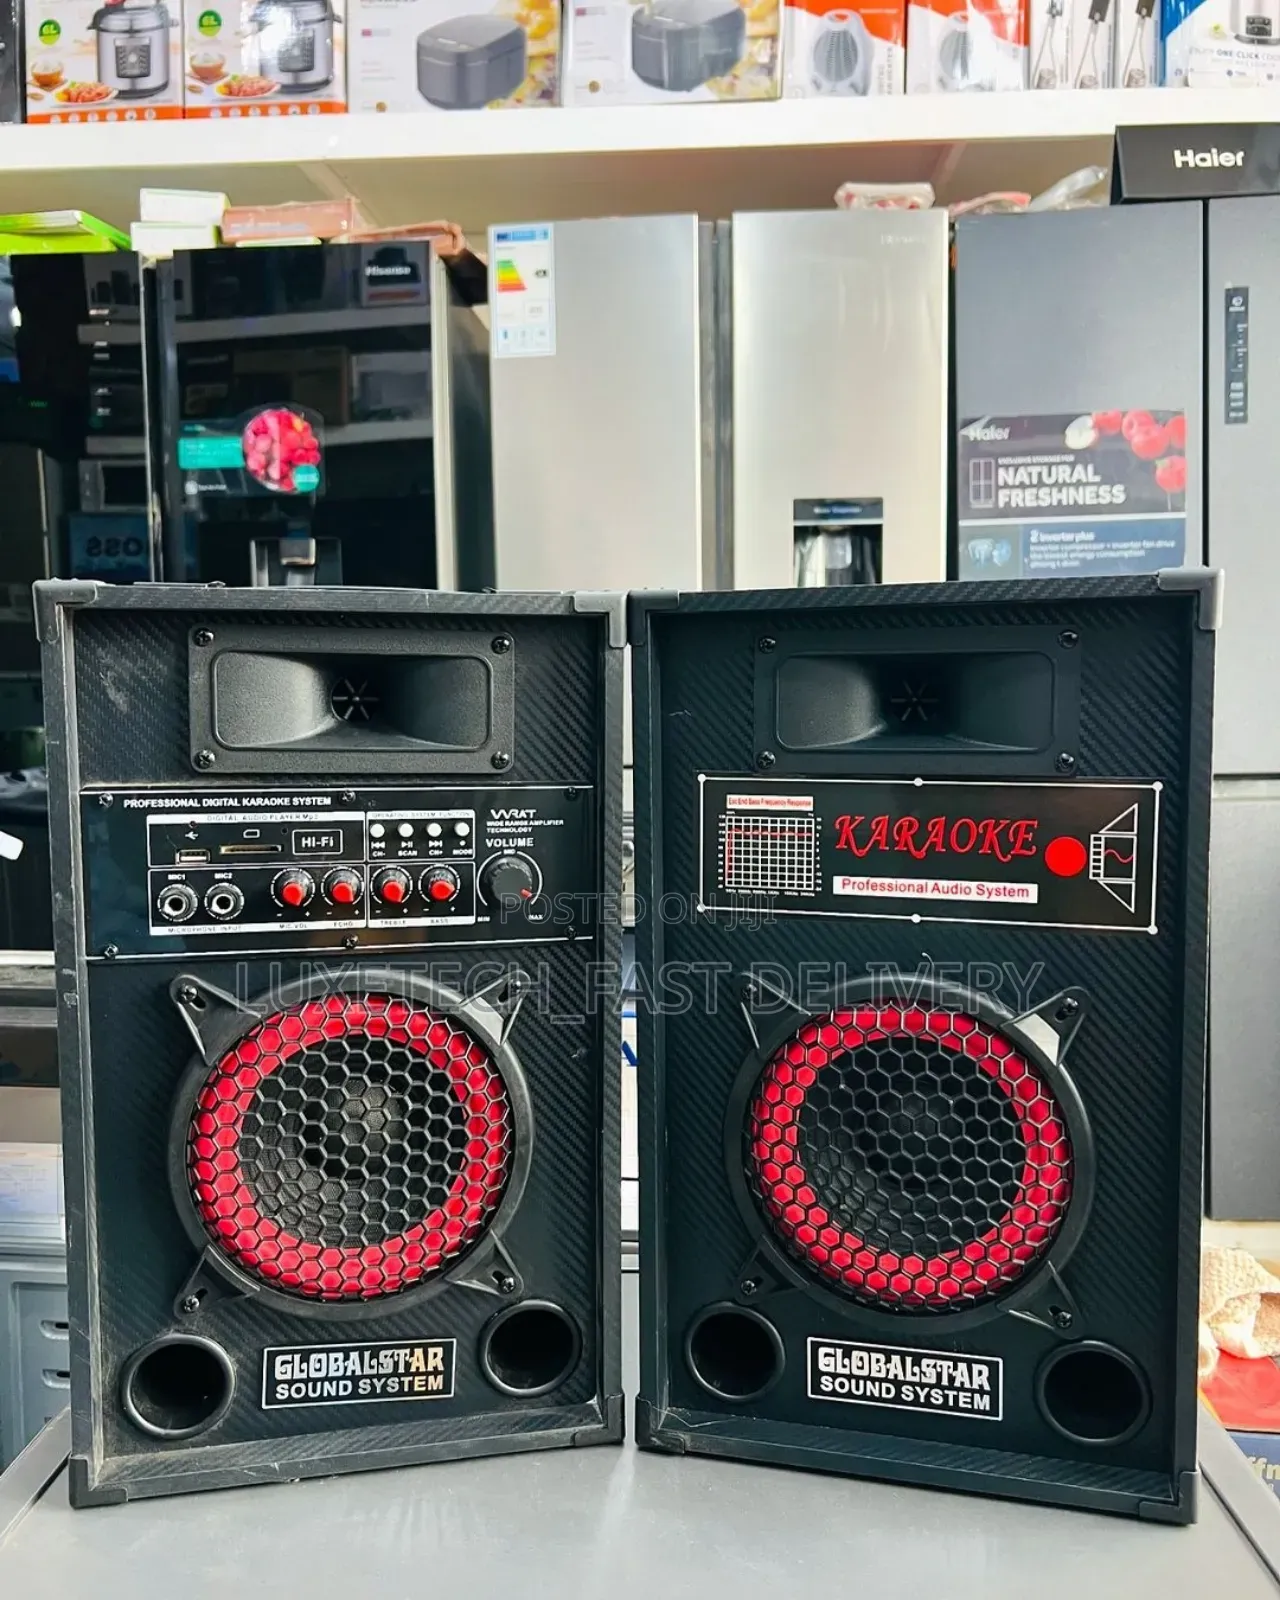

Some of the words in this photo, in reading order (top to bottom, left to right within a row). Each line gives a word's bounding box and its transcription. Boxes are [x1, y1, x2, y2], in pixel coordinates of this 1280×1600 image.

[1173, 147, 1245, 168] Haier
[997, 463, 1102, 487] NATURAL
[997, 484, 1127, 508] FRESHNESS
[123, 798, 201, 809] PROFESSIONAL
[202, 797, 241, 808] DIGITAL
[242, 797, 291, 807] KARAOKE
[292, 796, 332, 806] SYSTEM
[486, 826, 533, 834] TECHNOLOGY
[834, 815, 1039, 863] KARAOKE
[452, 848, 473, 856] MODE
[485, 837, 534, 848] VOLUME
[167, 873, 186, 881] MIC1
[214, 872, 233, 880] MIC2
[841, 878, 928, 894] Professional
[931, 881, 972, 896] Audio
[976, 883, 1030, 900] System
[167, 926, 216, 934] MICROPHONE
[274, 1346, 445, 1381] GLOBALSTAR
[817, 1346, 991, 1392] GLOBALSTAR
[275, 1379, 353, 1400] SOUND
[357, 1374, 444, 1395] SYSTEM
[819, 1375, 896, 1399] SOUND
[900, 1385, 991, 1411] SYSTEM
